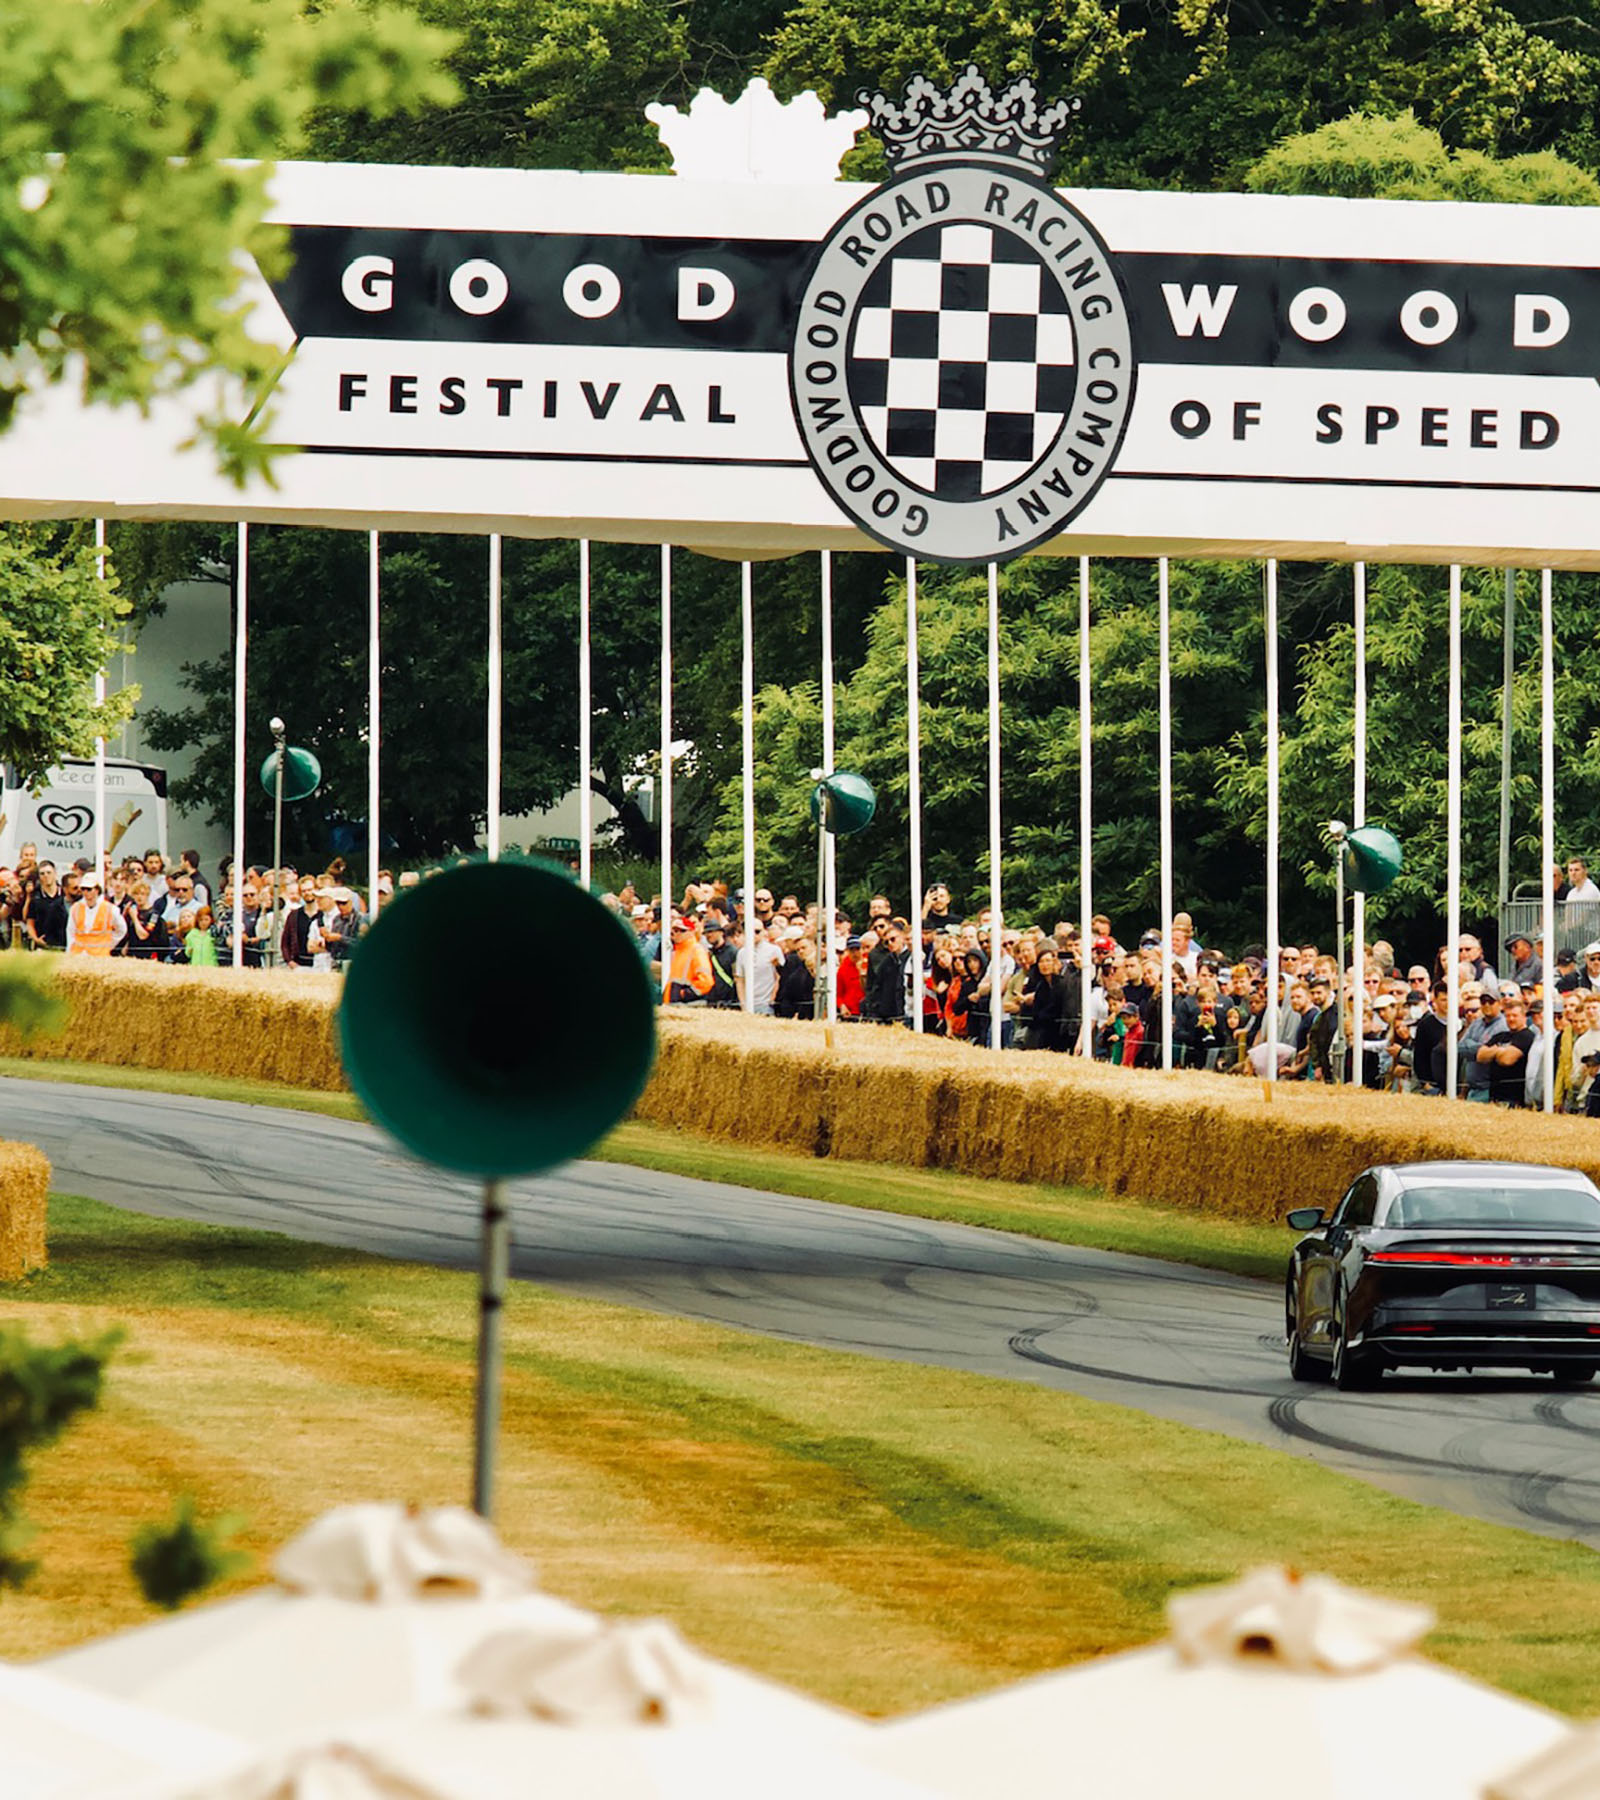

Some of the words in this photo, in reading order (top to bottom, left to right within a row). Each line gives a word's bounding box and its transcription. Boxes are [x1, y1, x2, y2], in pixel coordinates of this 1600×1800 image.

[840, 181, 951, 267] ROAD
[984, 182, 1113, 321] RACING
[341, 255, 736, 321] GOOD
[1161, 284, 1570, 348] WOOD
[338, 373, 736, 424] FESTIVAL
[1170, 400, 1262, 441] OF
[1316, 404, 1560, 450] SPEED
[806, 290, 929, 537] GOODWOOD
[995, 347, 1121, 541] COMPANY
[58, 770, 78, 783] ice
[82, 773, 125, 786] cram
[47, 839, 84, 849] WALL'S
